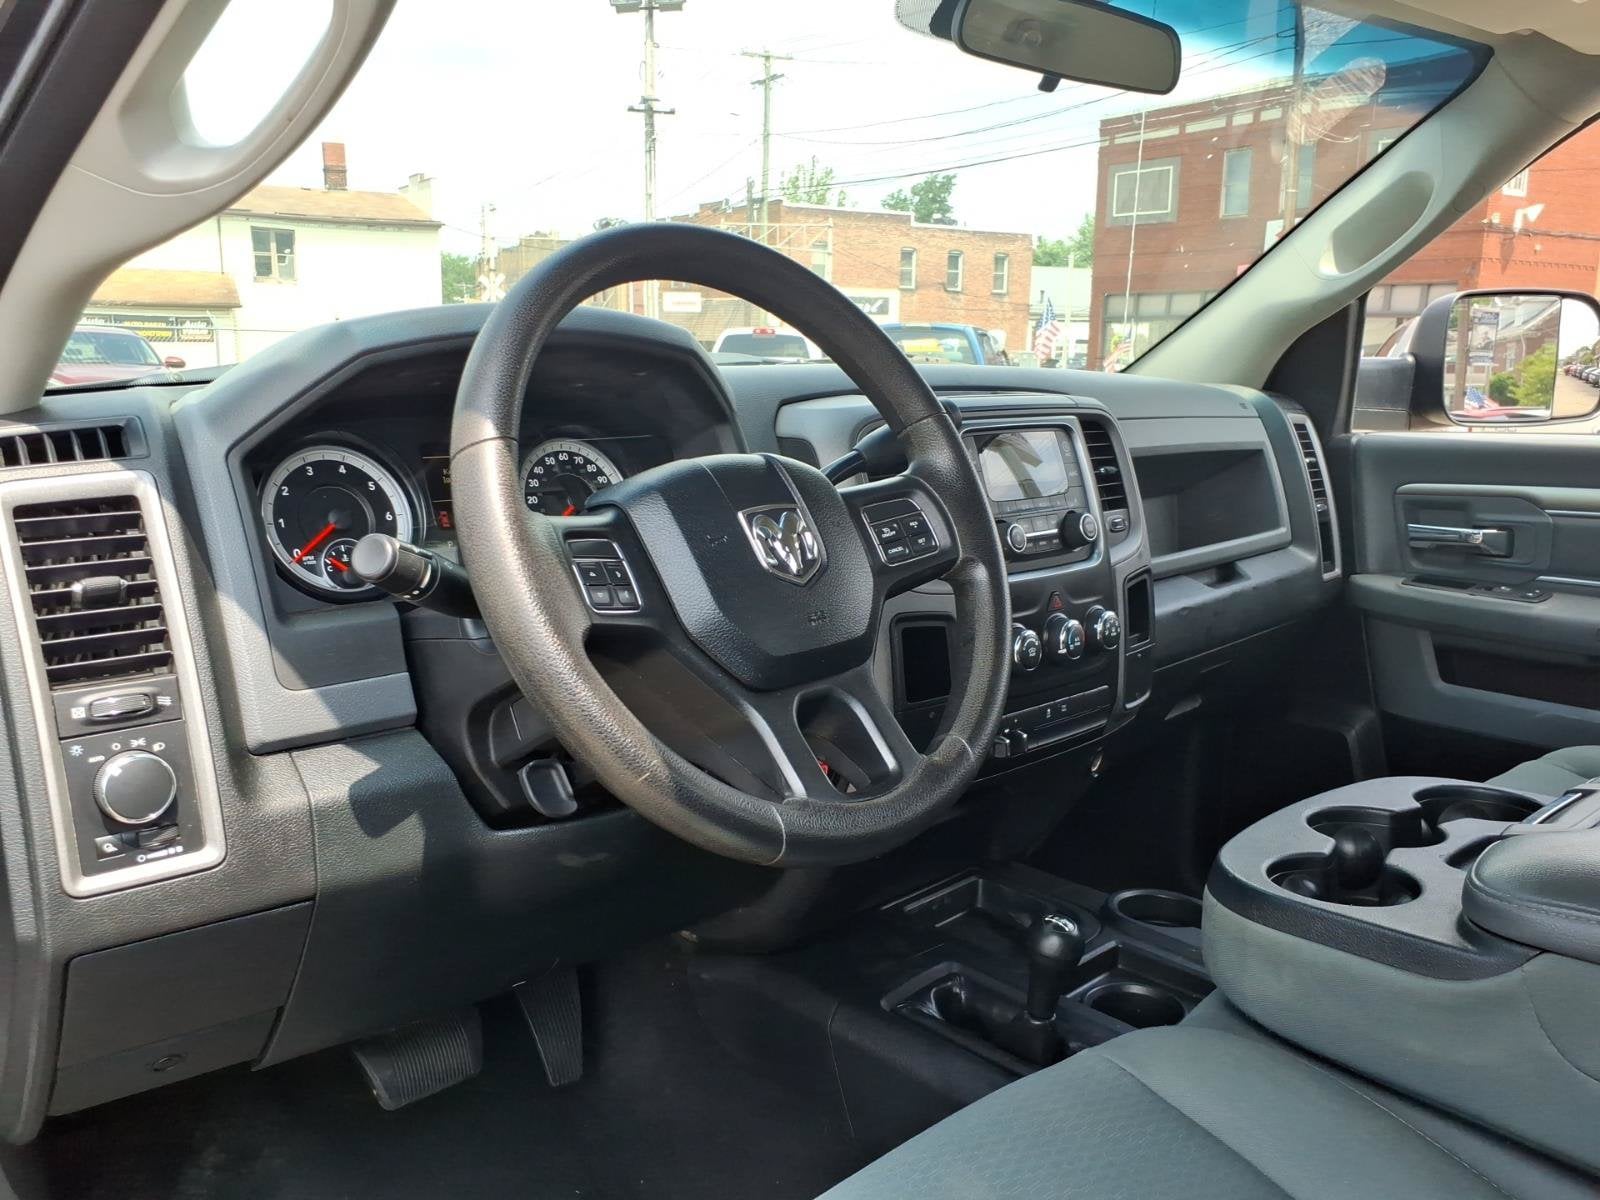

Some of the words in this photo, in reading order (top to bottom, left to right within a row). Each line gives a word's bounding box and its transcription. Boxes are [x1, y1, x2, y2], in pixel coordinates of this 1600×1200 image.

[545, 457, 555, 465] 50
[559, 453, 569, 461] 60
[574, 456, 584, 464] 70
[306, 466, 314, 476] 3
[339, 465, 347, 474] 4
[533, 466, 544, 474] 40
[586, 464, 597, 472] 80
[528, 479, 539, 487] 30
[597, 475, 608, 484] 90
[368, 481, 376, 491] 5
[281, 486, 290, 496] 2
[527, 496, 538, 504] 20
[385, 511, 393, 521] 6
[278, 518, 285, 528] 1
[293, 548, 302, 558] 0
